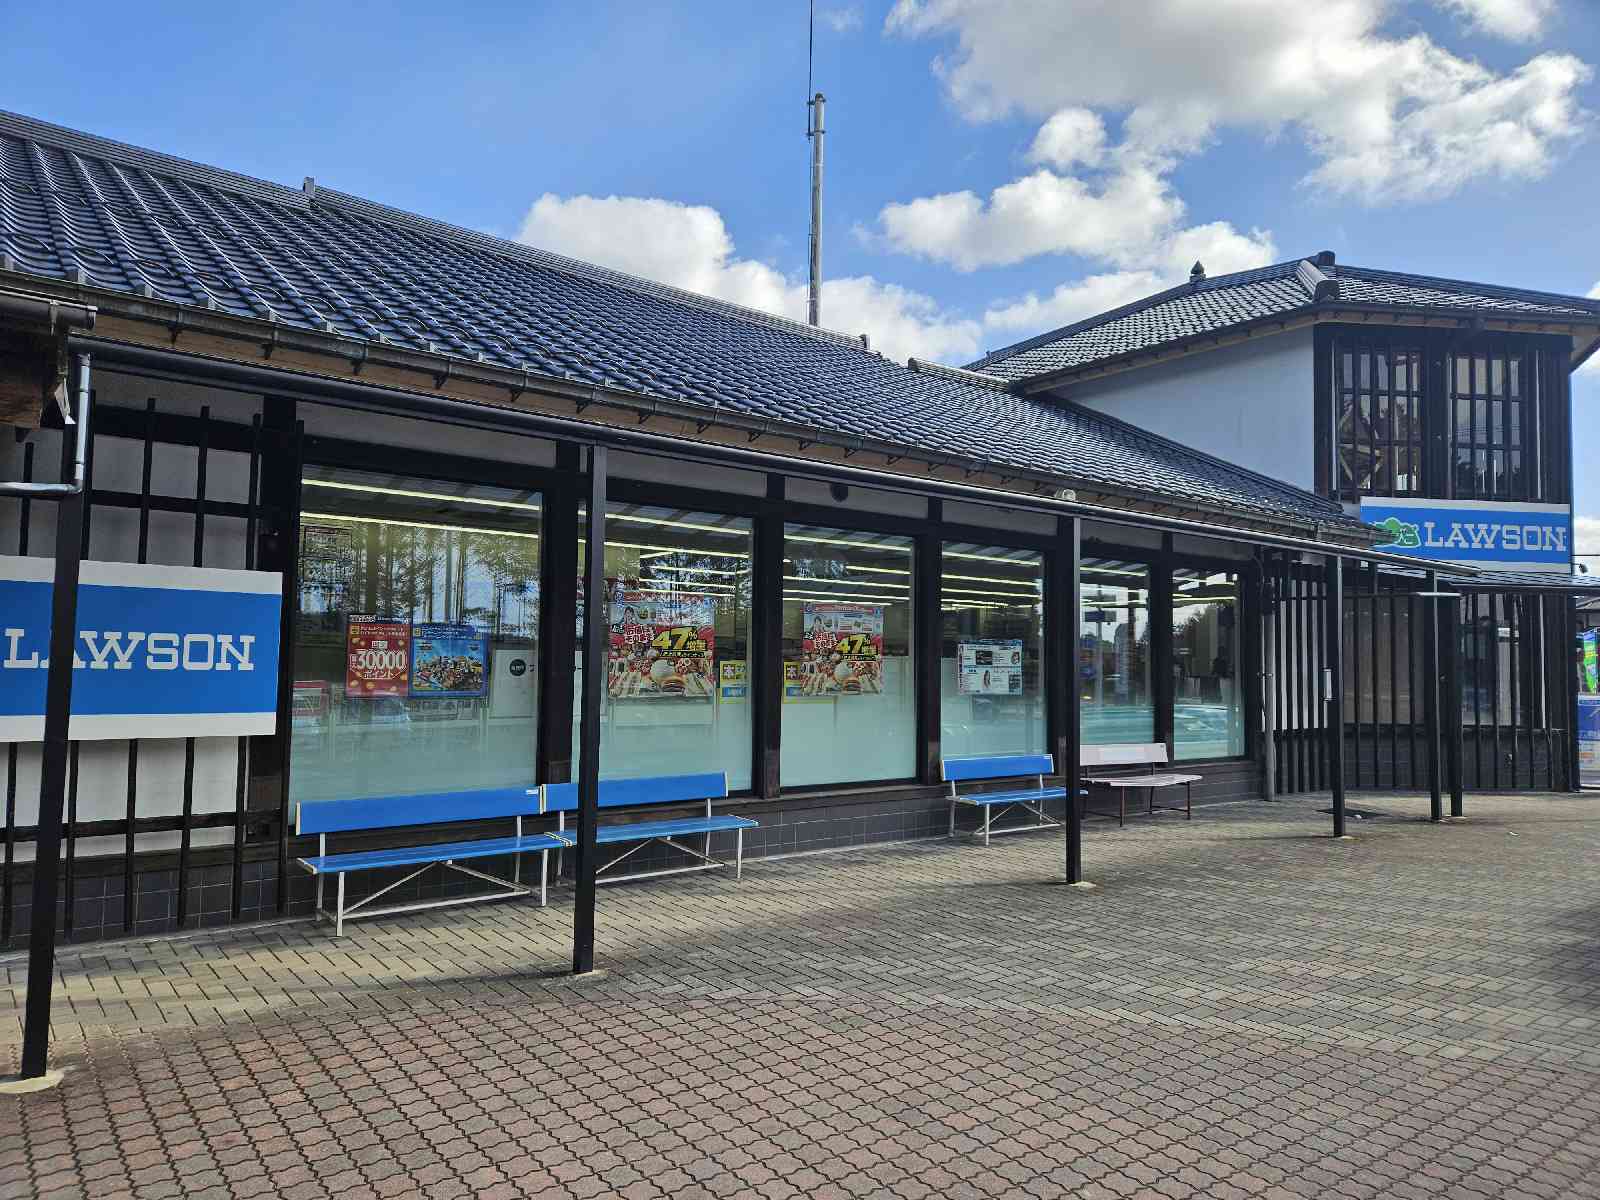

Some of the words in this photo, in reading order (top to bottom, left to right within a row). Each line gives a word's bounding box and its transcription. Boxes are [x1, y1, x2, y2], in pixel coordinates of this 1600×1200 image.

[1424, 521, 1566, 552] LAWSON
[3, 628, 256, 671] LWSON
[356, 650, 406, 669] 30000
